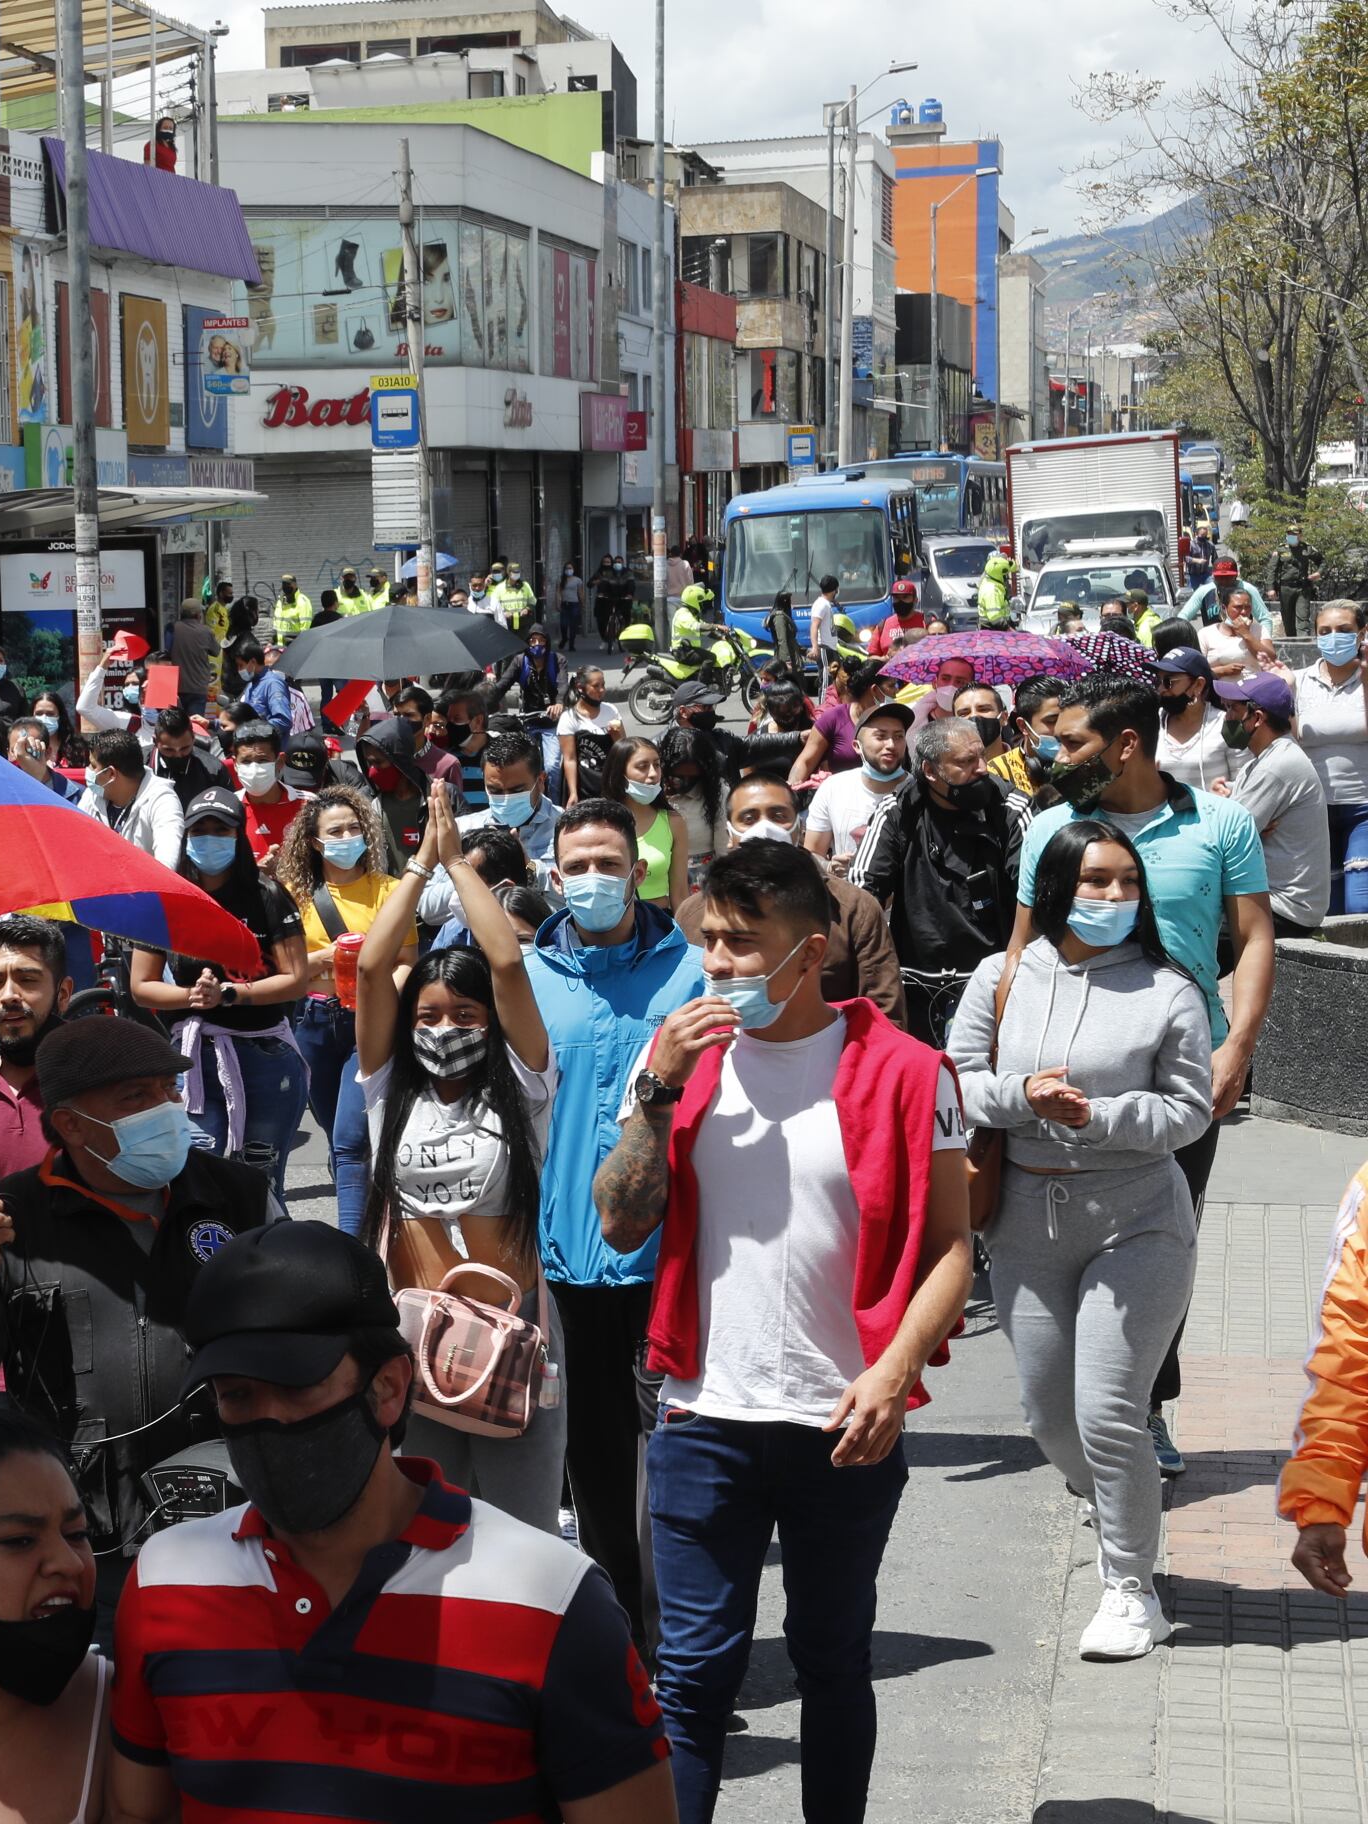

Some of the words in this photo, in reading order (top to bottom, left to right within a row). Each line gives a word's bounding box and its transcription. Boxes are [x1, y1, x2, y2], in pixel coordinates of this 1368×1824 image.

[204, 318, 247, 328] IMPLANTES
[395, 343, 443, 357] Bta
[378, 377, 410, 387] 031A10
[263, 386, 372, 428] Bat
[48, 542, 76, 551] JCDec
[398, 1137, 475, 1169] ONLY
[415, 1177, 475, 1205] YOU
